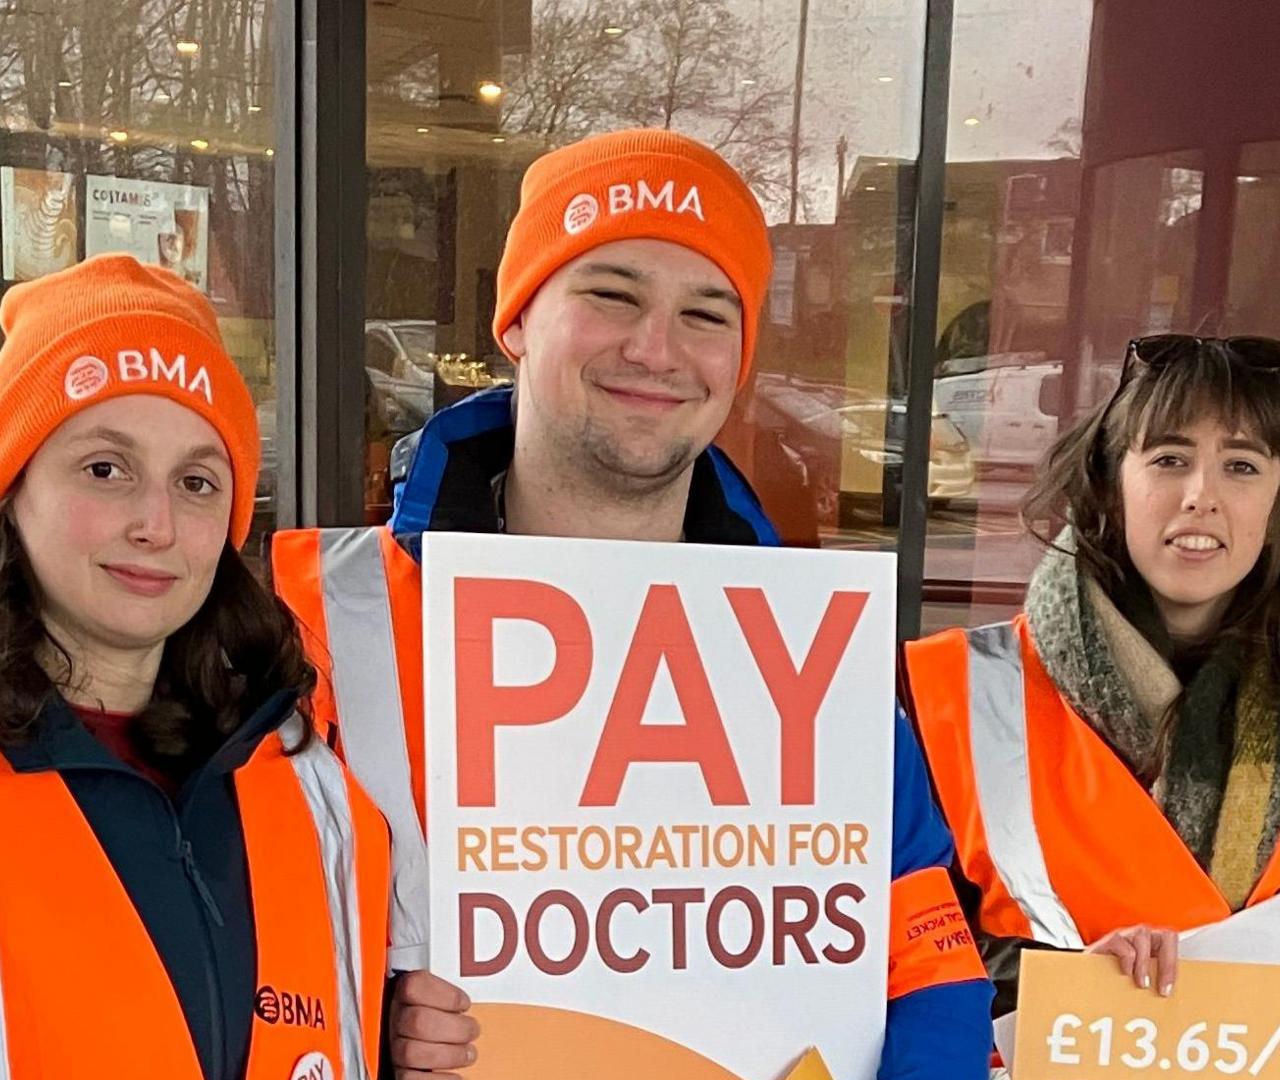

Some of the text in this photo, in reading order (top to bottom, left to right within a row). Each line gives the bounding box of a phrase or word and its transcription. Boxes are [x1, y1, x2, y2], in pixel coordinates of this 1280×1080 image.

[608, 179, 705, 222] BMA
[117, 347, 213, 405] BMA
[454, 577, 871, 808] PAY
[457, 823, 869, 872] RESTORATION FOR
[459, 882, 867, 978] DOCTORS
